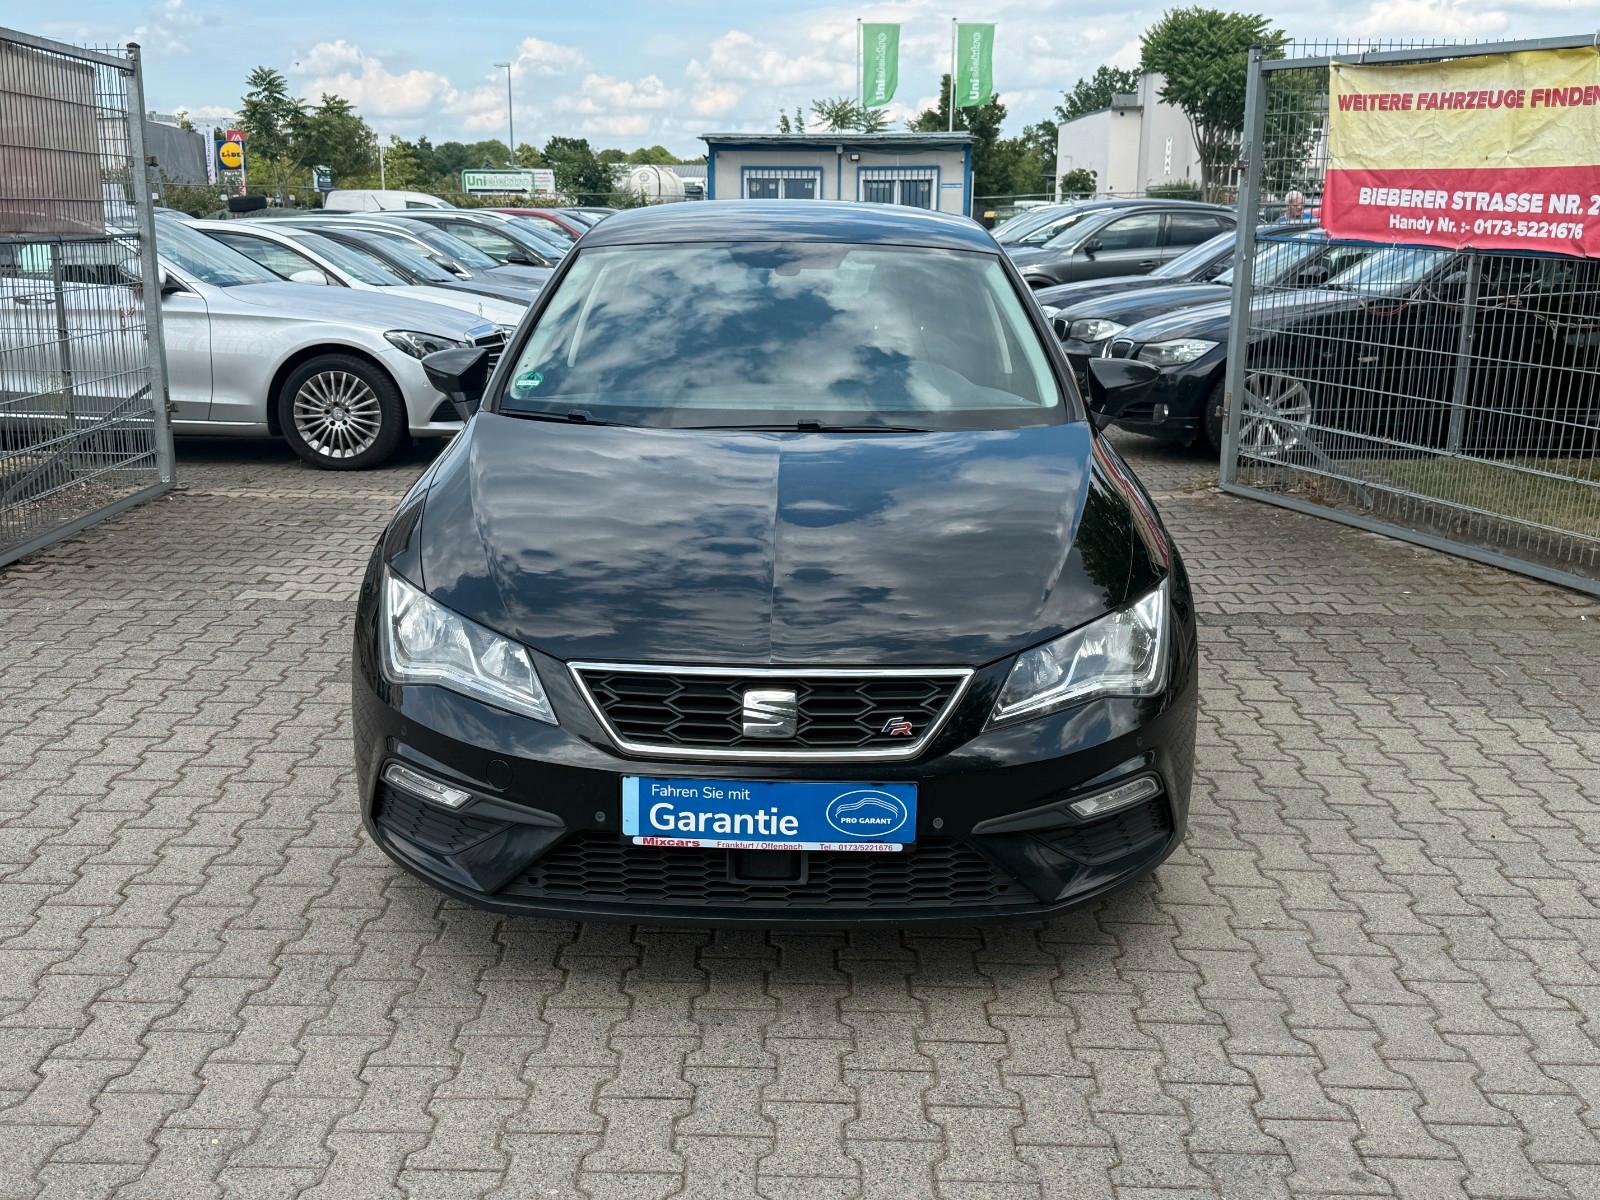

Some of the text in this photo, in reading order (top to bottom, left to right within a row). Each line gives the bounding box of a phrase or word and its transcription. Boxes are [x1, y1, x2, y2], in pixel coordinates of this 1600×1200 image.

[1337, 85, 1600, 111] WEITERE FAHRZEUGE FINDEN
[1358, 187, 1448, 209] BIEBERER
[1450, 191, 1544, 214] STRASSE
[1548, 193, 1583, 215] NR.
[1389, 213, 1434, 234] Handy
[1437, 216, 1457, 232] Nr.
[1473, 218, 1584, 239] 0173-5221676
[881, 716, 913, 735] FR
[651, 784, 750, 800] Fahren Sie mit
[649, 802, 799, 836] Garantie
[642, 837, 701, 847] Mixcars
[716, 841, 754, 849] Frankfurt
[761, 842, 803, 850] Offenbach
[838, 843, 893, 851] 0173/5221676
